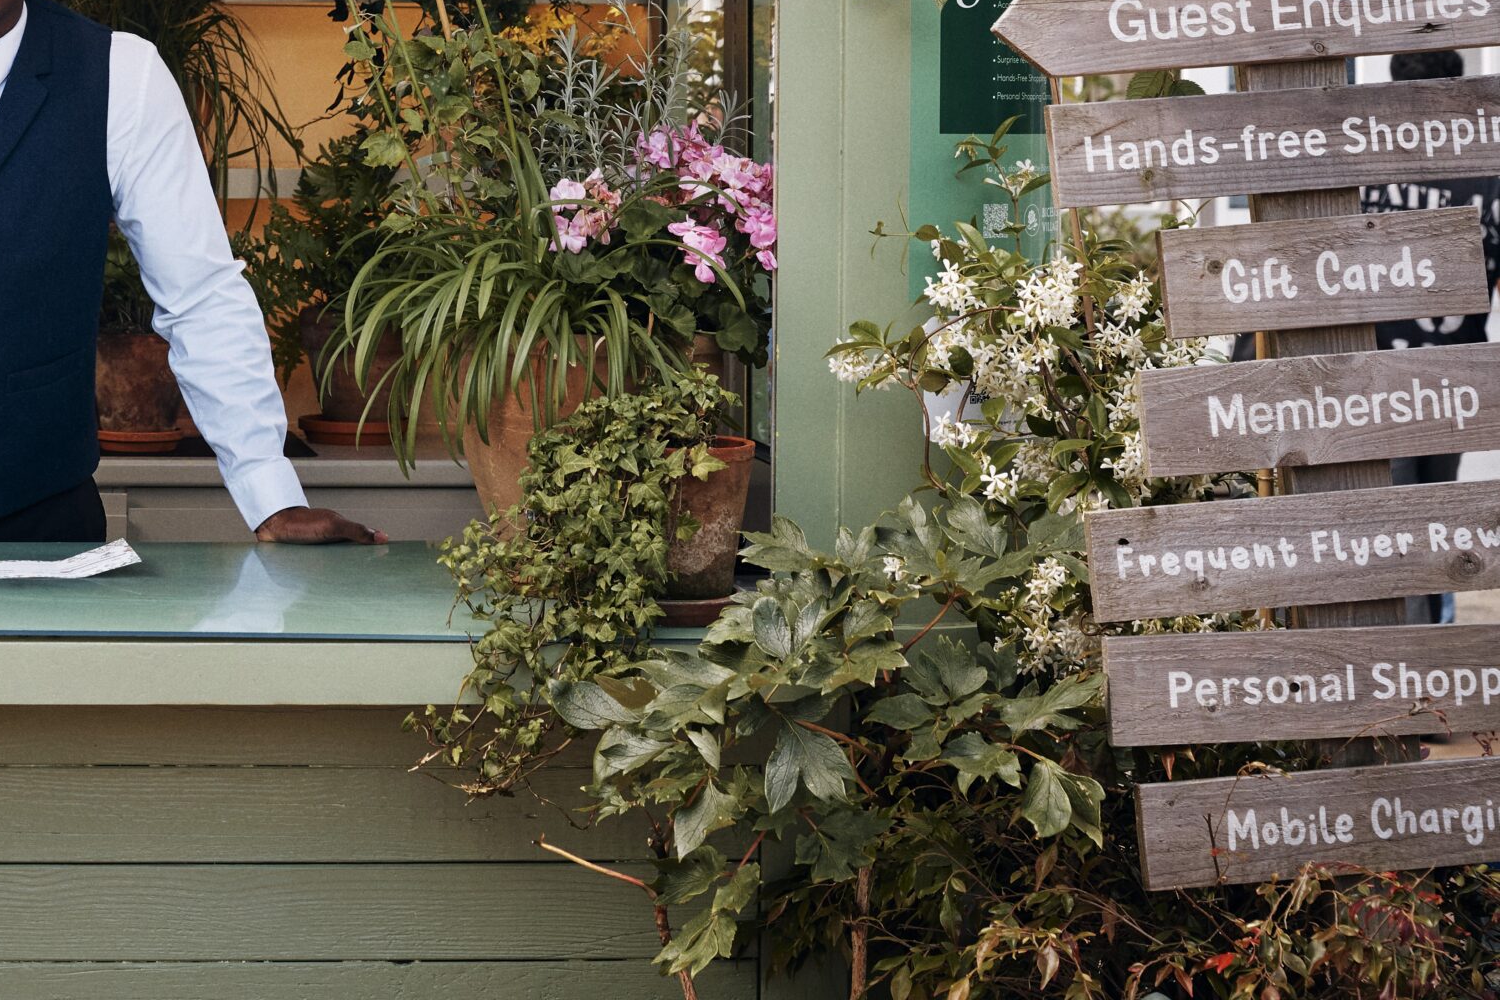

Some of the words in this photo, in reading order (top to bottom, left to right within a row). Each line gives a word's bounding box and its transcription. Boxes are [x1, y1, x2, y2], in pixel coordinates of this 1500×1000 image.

[1083, 124, 1327, 173] Hands-free
[1221, 256, 1299, 304] Gift
[1316, 245, 1436, 296] Cards
[1207, 377, 1480, 437] Membership
[1116, 537, 1299, 580] Frequent
[1311, 529, 1414, 567] Flyer
[1168, 664, 1356, 709] Personal
[1372, 662, 1500, 706] Shopp
[1227, 805, 1354, 852] Mobile
[1370, 797, 1500, 846] Chargi
